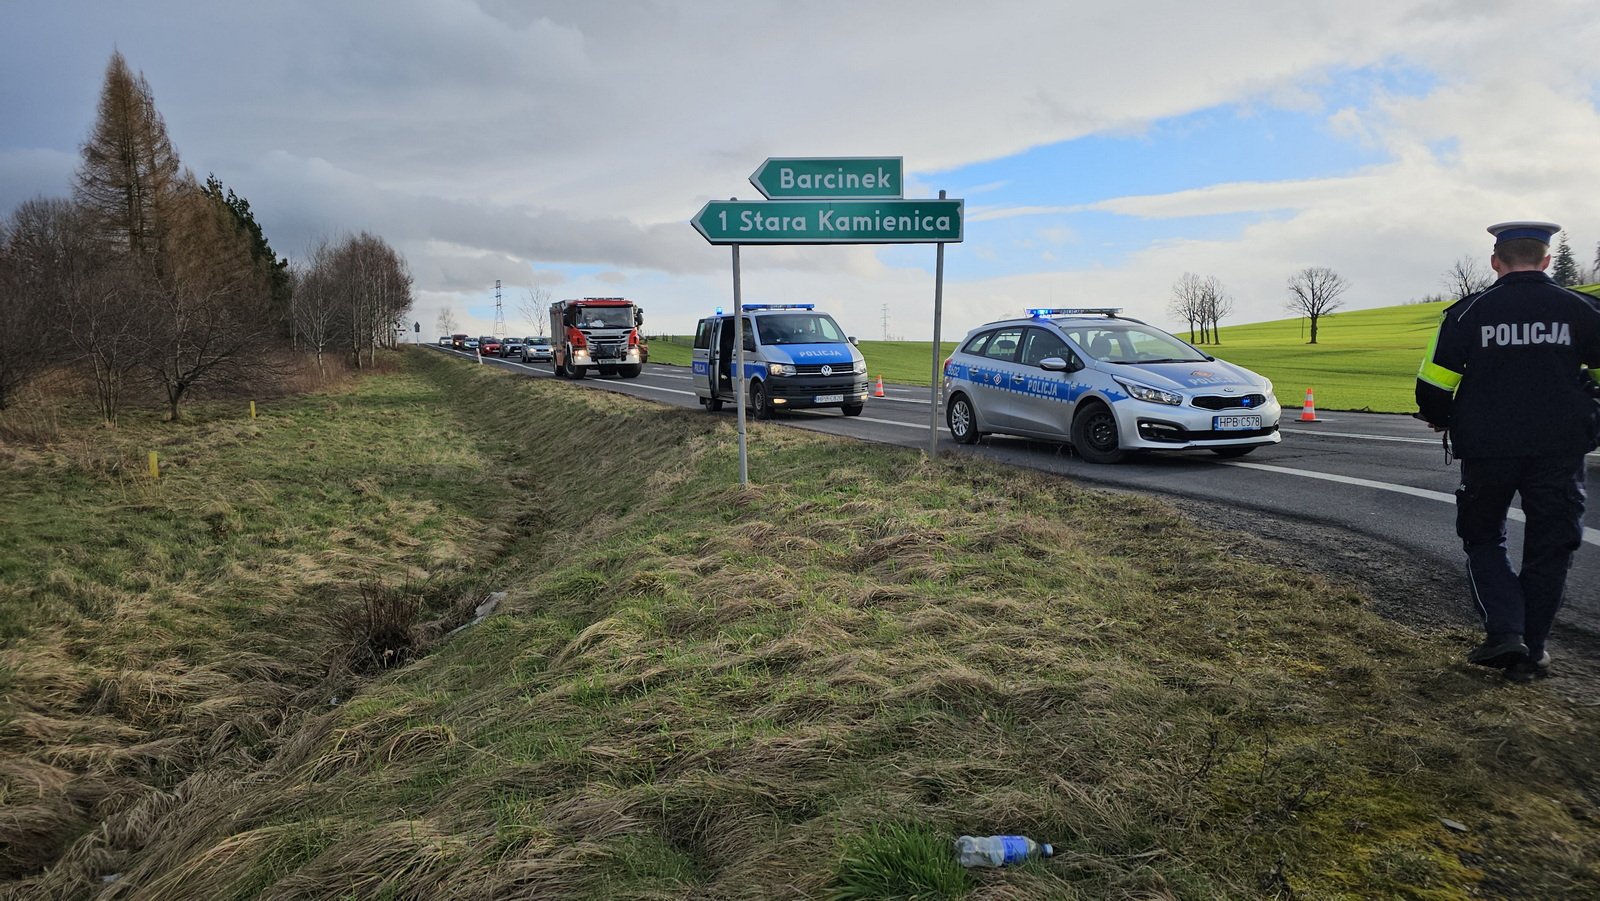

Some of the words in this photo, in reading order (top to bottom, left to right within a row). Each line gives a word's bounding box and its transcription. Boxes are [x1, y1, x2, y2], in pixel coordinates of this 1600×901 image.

[780, 167, 891, 189] Barcinek
[718, 210, 728, 231] 1
[739, 210, 807, 231] Stara
[818, 209, 951, 231] Kamienica
[1481, 322, 1572, 348] POLICJA
[799, 350, 843, 358] POLICJA
[1027, 380, 1058, 396] POLICJA
[1219, 417, 1239, 428] HPB
[1240, 416, 1260, 427] C578
